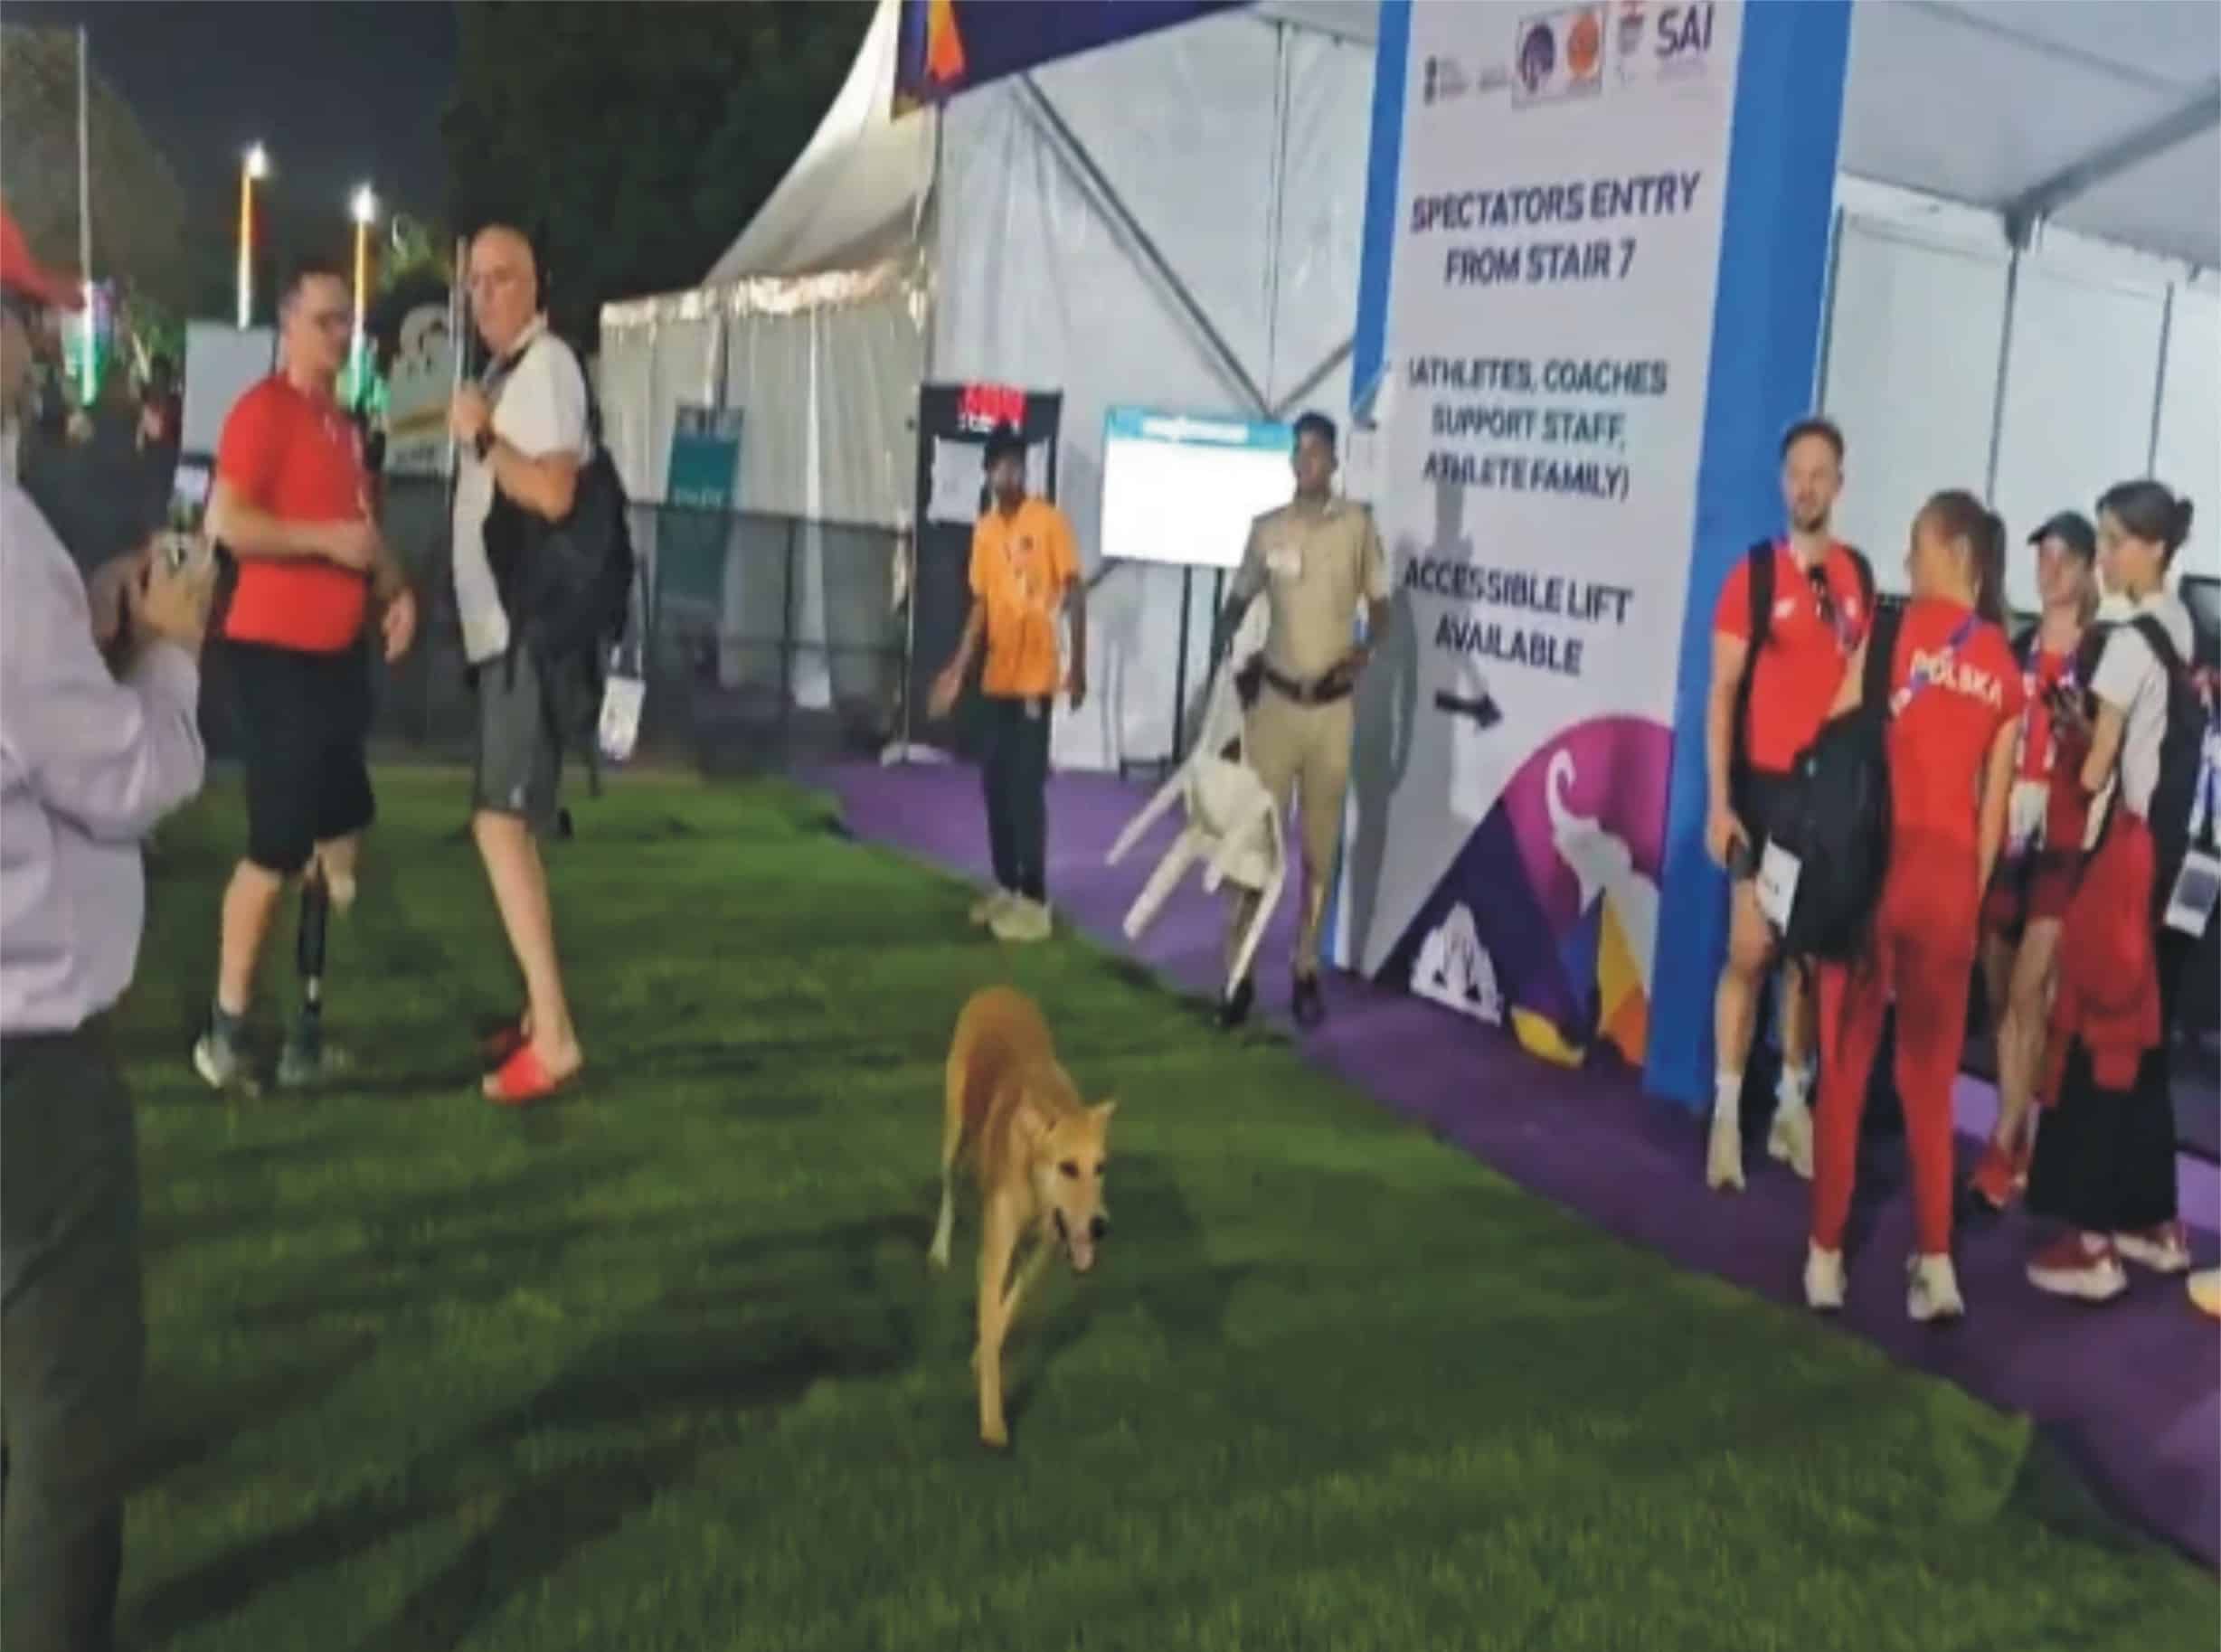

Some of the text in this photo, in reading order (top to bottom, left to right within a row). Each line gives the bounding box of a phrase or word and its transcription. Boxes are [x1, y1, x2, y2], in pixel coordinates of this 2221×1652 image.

[1655, 3, 1714, 56] SAI
[1411, 172, 1702, 233] SPECTATORS ENTRY
[1445, 239, 1637, 286] FROM STAIR 7
[1544, 359, 1668, 396] COACHES
[1432, 406, 1535, 440] SUPPORT
[1423, 451, 1630, 502] ATHLETE FAMILY)
[1403, 556, 1635, 624] ACCESSIBLE LIFT
[1435, 612, 1584, 676] AVAILABLE
[1910, 648, 2003, 711] POLSKA
